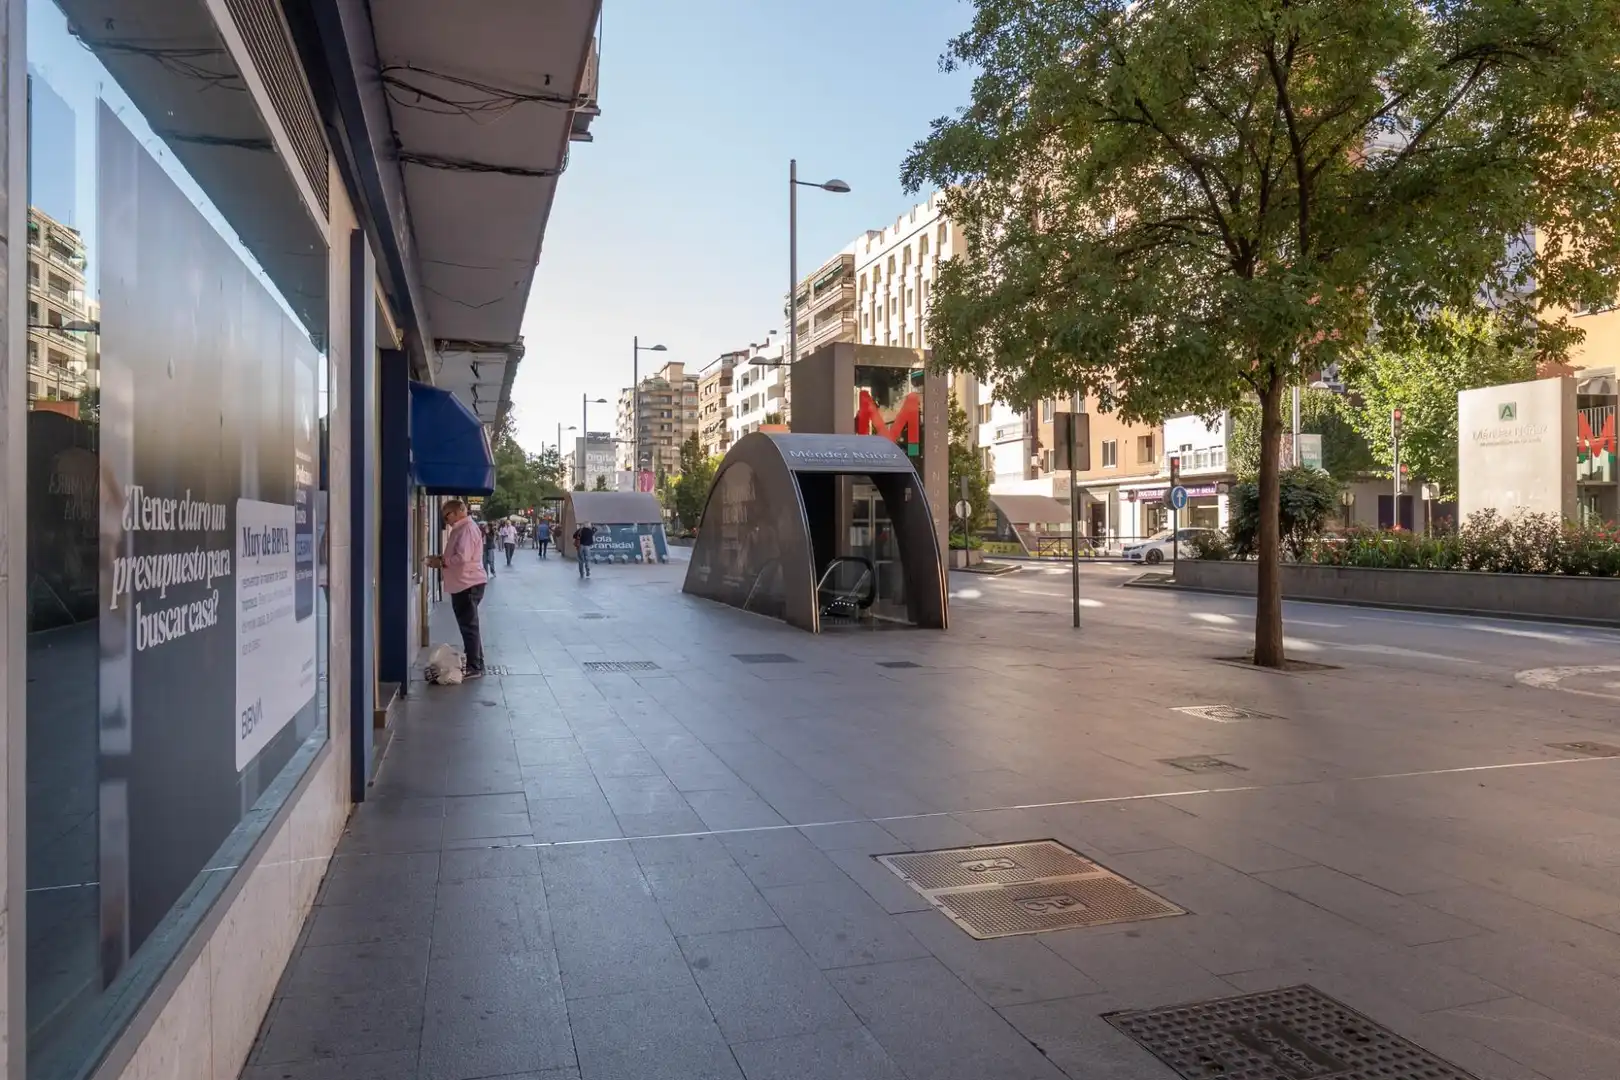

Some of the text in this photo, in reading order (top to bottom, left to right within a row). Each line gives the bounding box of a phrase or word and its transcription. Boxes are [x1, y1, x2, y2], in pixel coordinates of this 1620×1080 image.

[789, 450, 849, 458] Méndez
[122, 484, 226, 531] ¿Tener claro un
[242, 527, 261, 565] Muy
[262, 525, 270, 556] de
[271, 527, 289, 555] BBVA
[109, 545, 206, 610] presupuesto
[206, 549, 231, 589] para
[136, 601, 188, 651] buscar
[188, 589, 220, 633] casa?
[241, 697, 263, 740] BBVA
